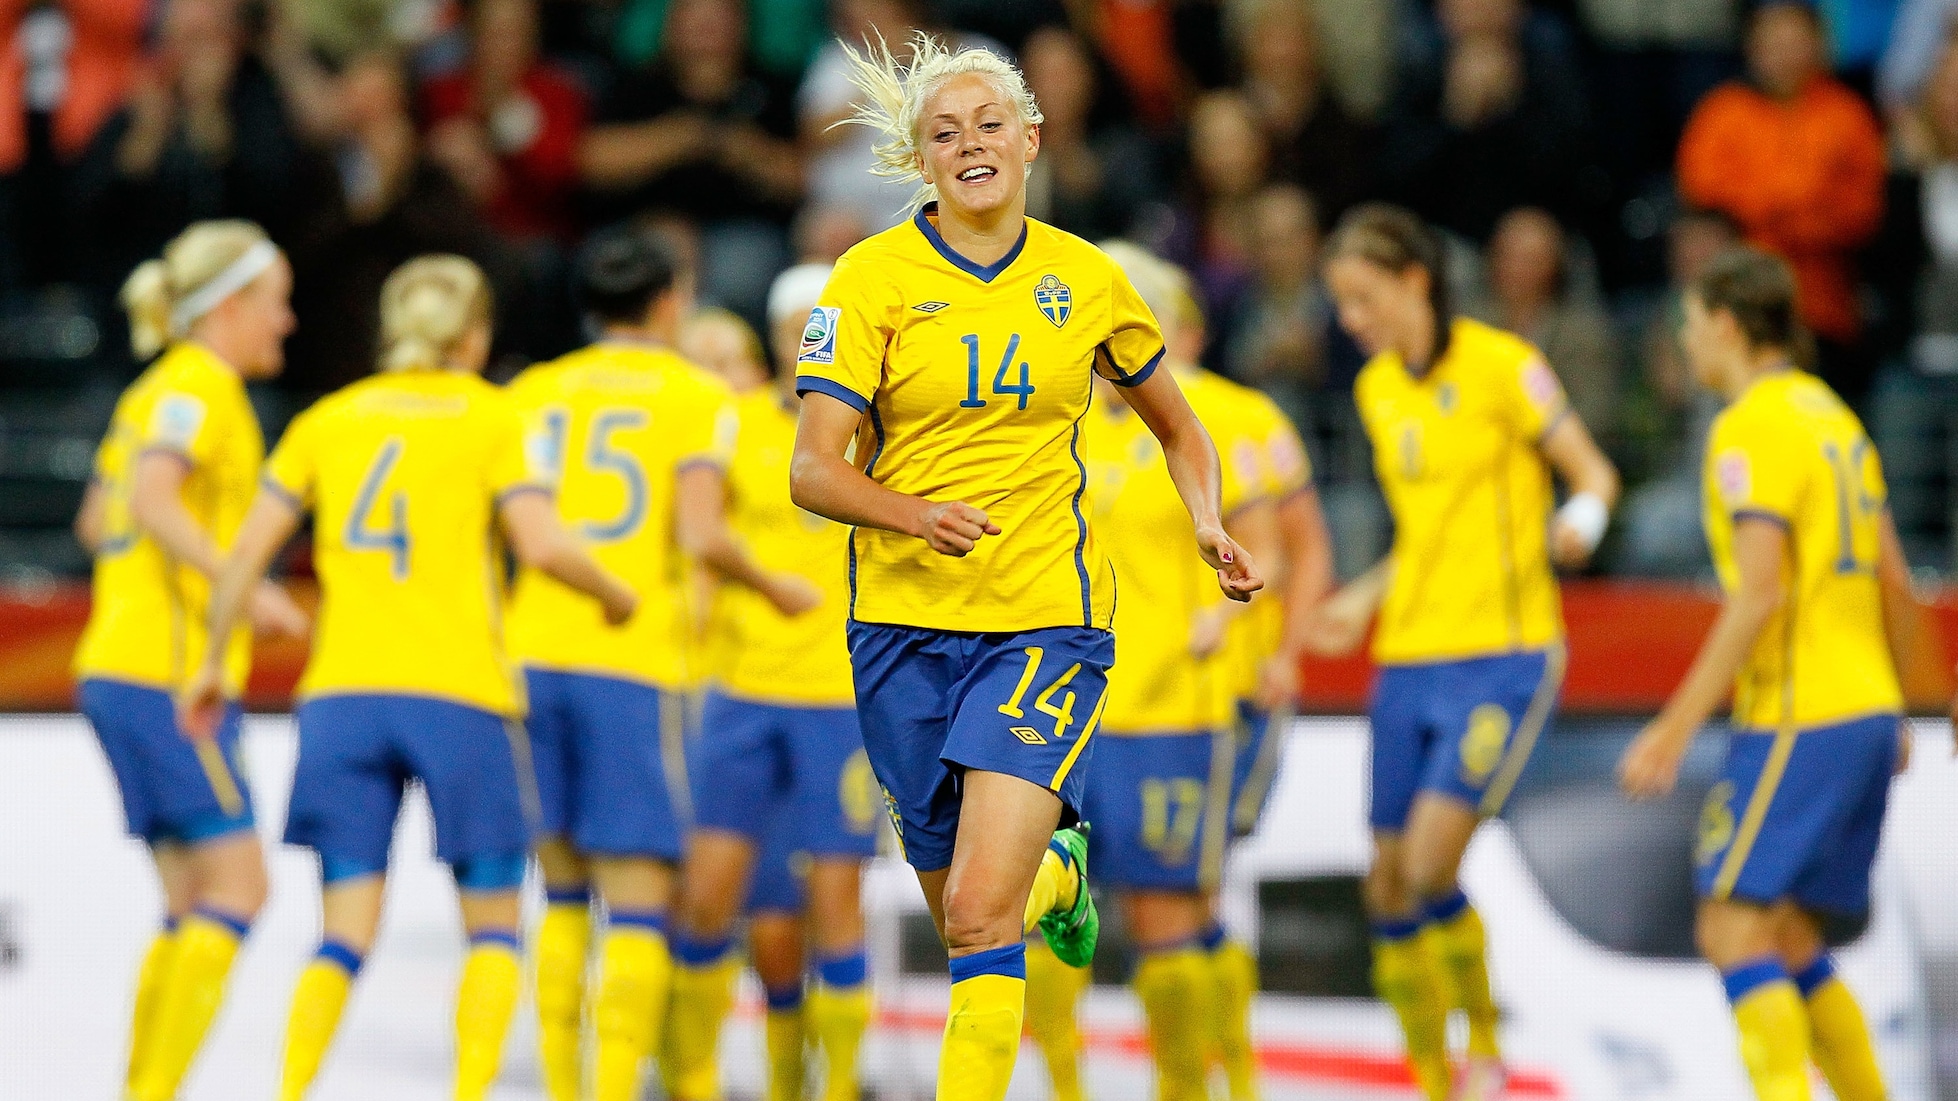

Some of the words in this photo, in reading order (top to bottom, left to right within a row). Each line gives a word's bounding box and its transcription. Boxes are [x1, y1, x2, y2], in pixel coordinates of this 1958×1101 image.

[815, 350, 832, 359] FIFA
[960, 333, 1036, 411] 14
[342, 434, 412, 583] 4
[543, 407, 652, 543] 15
[997, 646, 1082, 738] 14
[1139, 777, 1204, 865] 17
